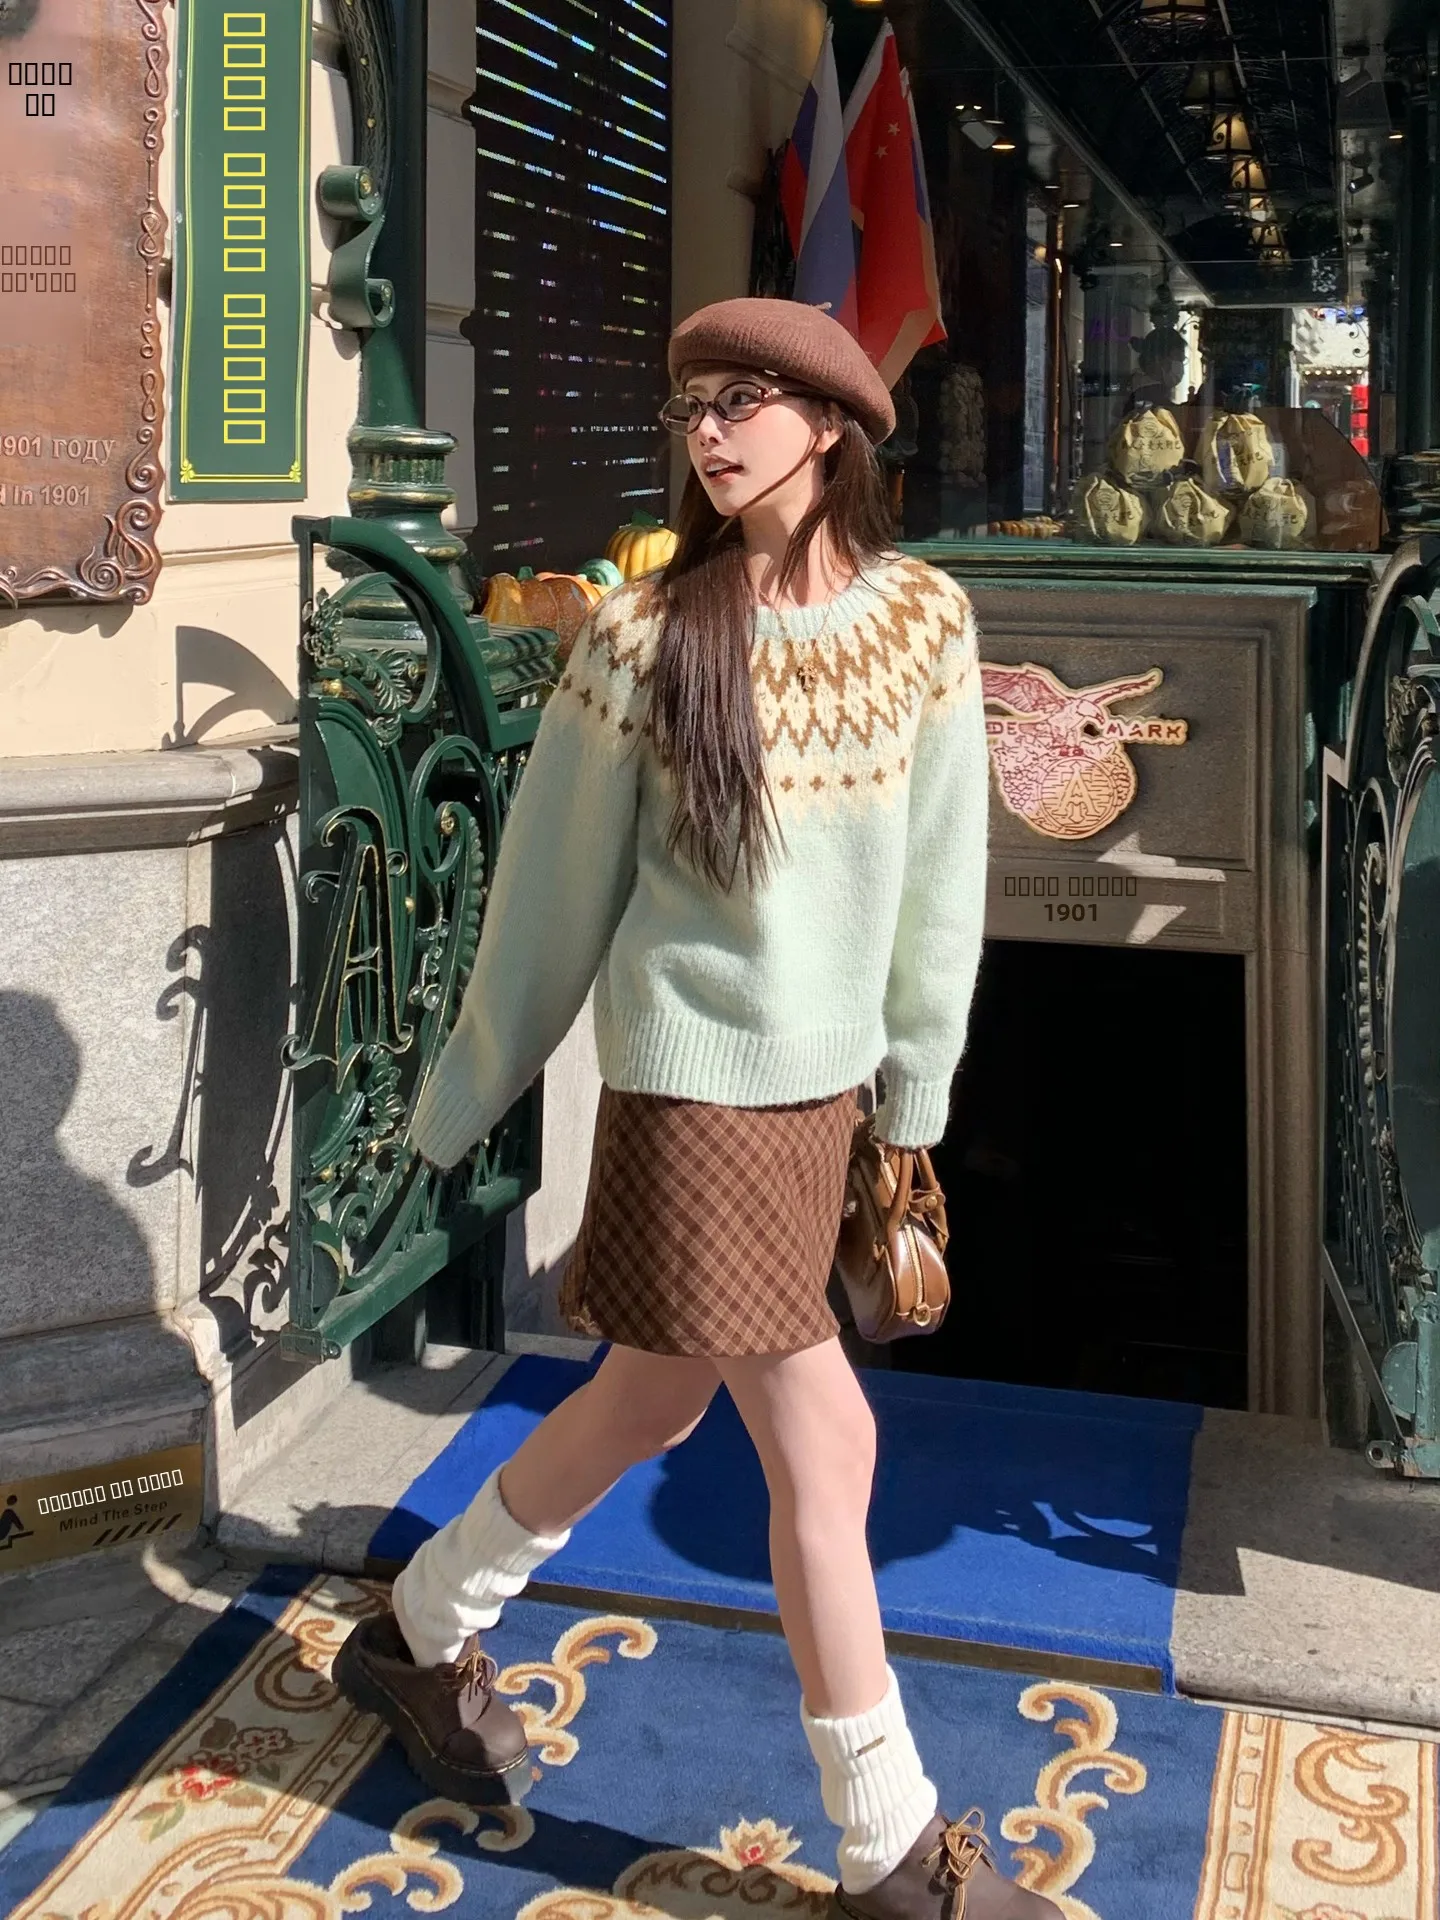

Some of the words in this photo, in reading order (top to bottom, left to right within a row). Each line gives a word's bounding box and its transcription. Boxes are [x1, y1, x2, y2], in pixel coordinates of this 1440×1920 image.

[0, 436, 41, 457] 901
[52, 439, 116, 466] году
[40, 485, 90, 506] 1901
[1106, 723, 1182, 738] MARK
[1044, 904, 1097, 921] 1901
[59, 1513, 98, 1532] Mind
[102, 1508, 129, 1522] The
[134, 1501, 168, 1516] Step
